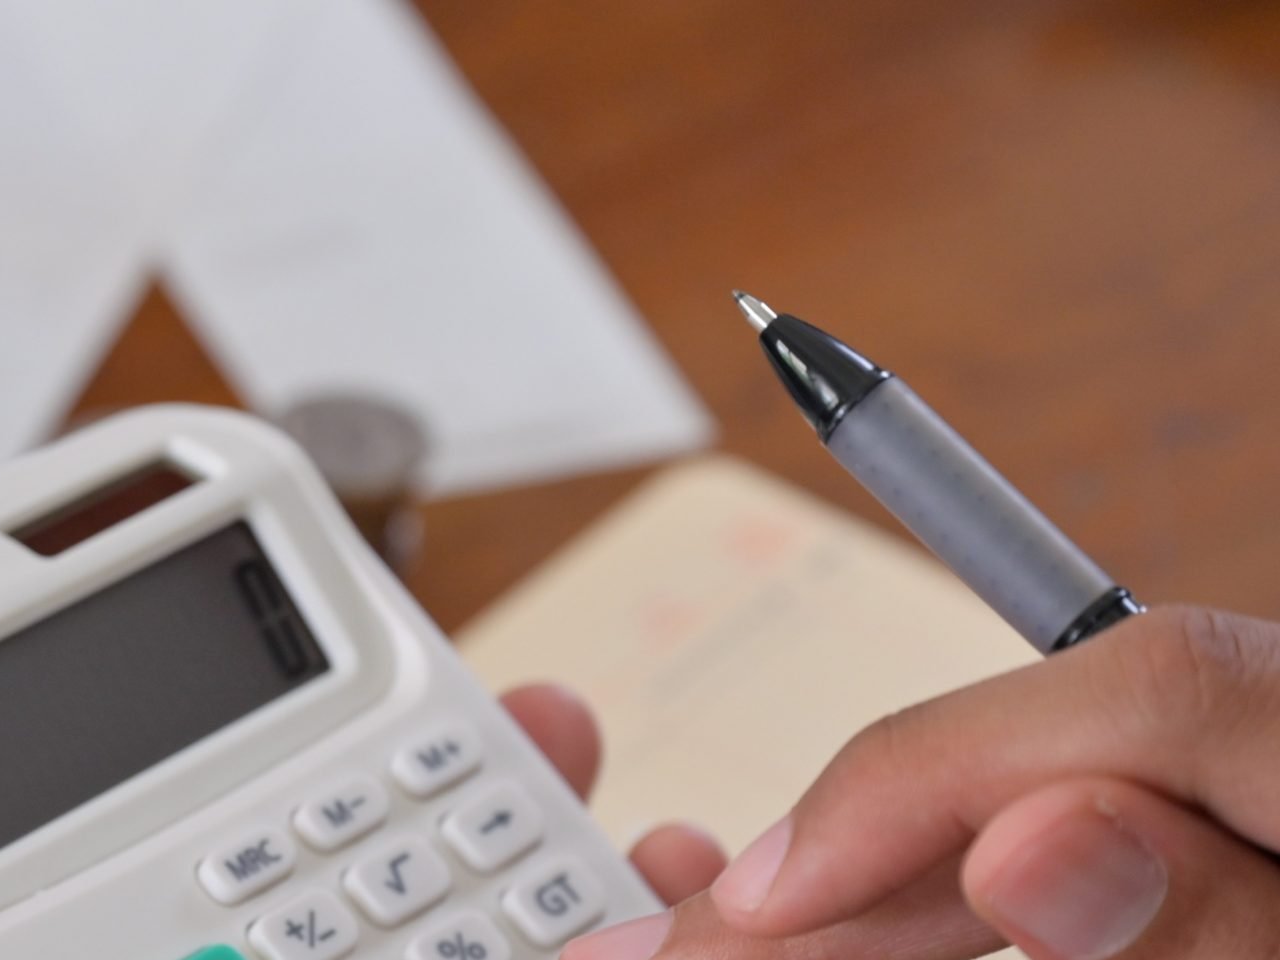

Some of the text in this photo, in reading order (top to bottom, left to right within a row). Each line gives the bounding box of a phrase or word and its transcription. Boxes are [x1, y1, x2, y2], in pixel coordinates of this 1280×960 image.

[416, 740, 461, 773] M+
[224, 838, 284, 882] MRC
[534, 872, 582, 918] GT
